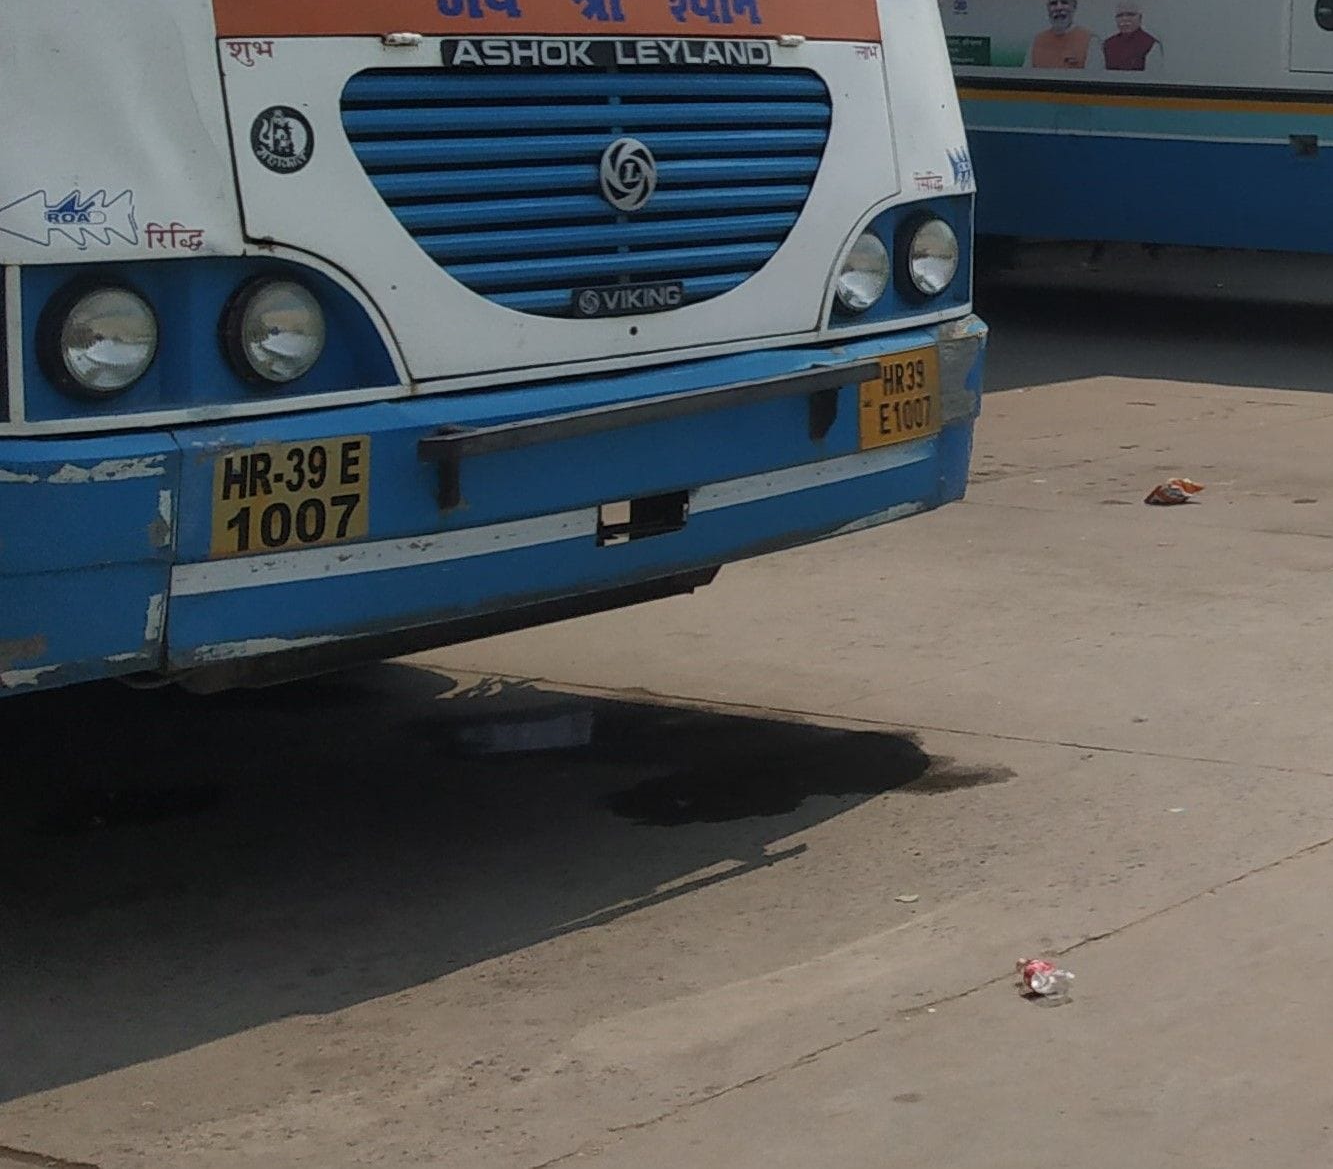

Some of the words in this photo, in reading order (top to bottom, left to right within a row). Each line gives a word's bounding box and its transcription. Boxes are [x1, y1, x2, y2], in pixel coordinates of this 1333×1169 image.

[226, 40, 274, 68] शुभ
[452, 39, 593, 67] ASHOK
[614, 39, 772, 67] LEYLAND
[145, 222, 205, 250] रिद्धि
[602, 285, 682, 310] VIKING
[881, 357, 927, 394] HR39
[876, 395, 934, 437] E1007
[222, 446, 327, 502] HR-39
[340, 441, 362, 486] E
[225, 495, 360, 553] 1007
